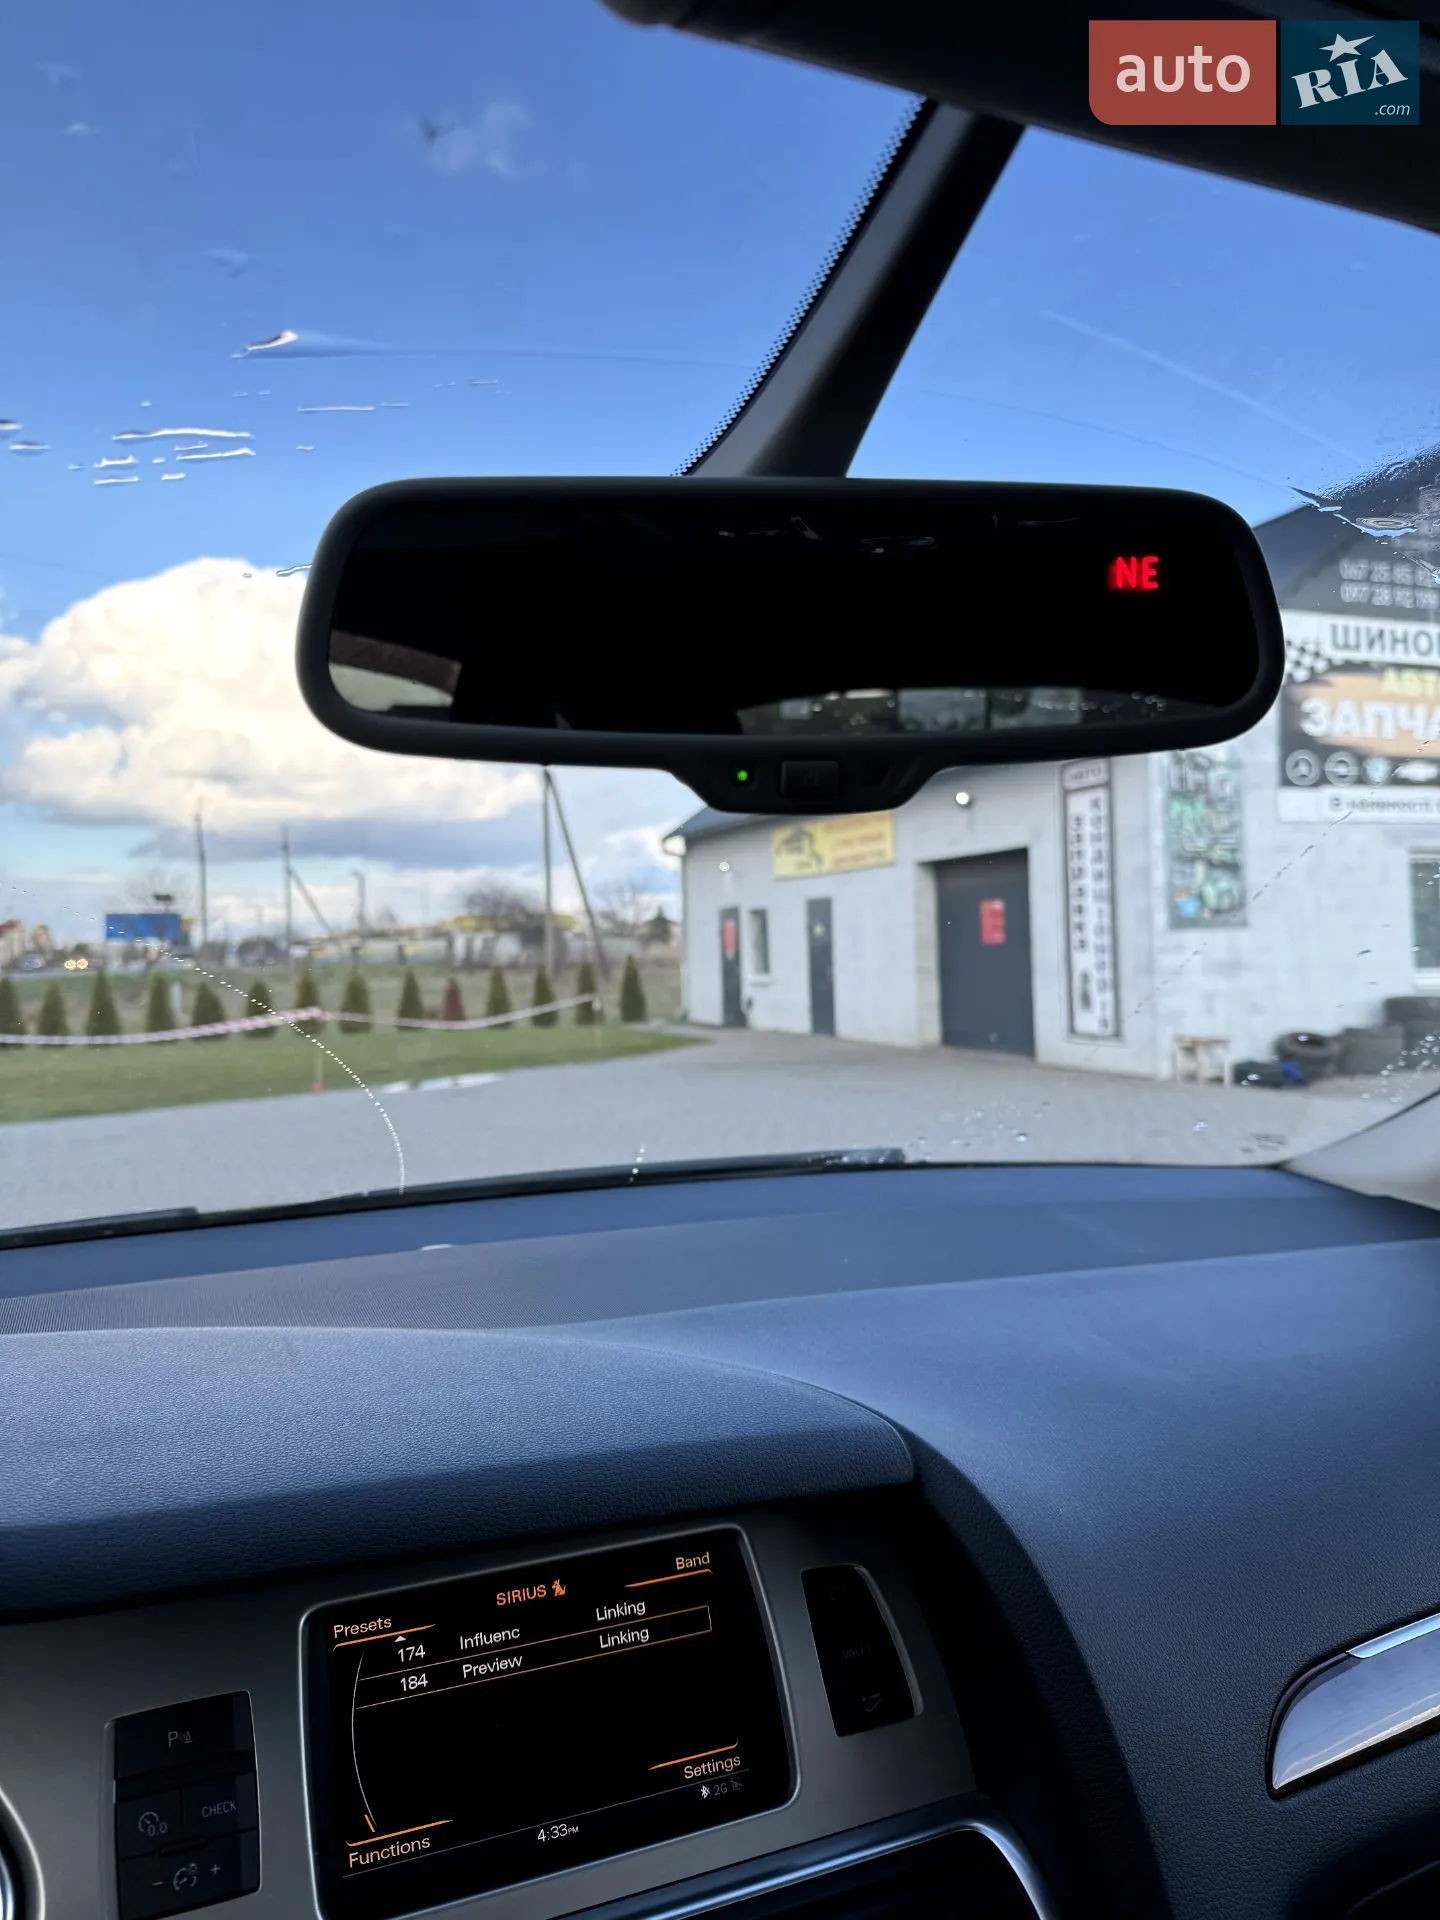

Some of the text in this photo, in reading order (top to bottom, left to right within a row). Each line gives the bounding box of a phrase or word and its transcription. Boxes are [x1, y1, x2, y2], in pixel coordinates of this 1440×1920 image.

[1114, 555, 1159, 588] NE
[1332, 625, 1440, 657] ШИНО
[1381, 668, 1440, 698] АВТ
[676, 1552, 709, 1570] Band
[497, 1585, 546, 1605] SIRIUS
[333, 1615, 392, 1639] Presets
[397, 1599, 647, 1664] 174 Influenc Linking
[400, 1627, 650, 1692] 184 Preview Linking
[683, 1754, 742, 1780] Settings
[201, 1800, 237, 1818] CHECK
[348, 1836, 431, 1869] Functions
